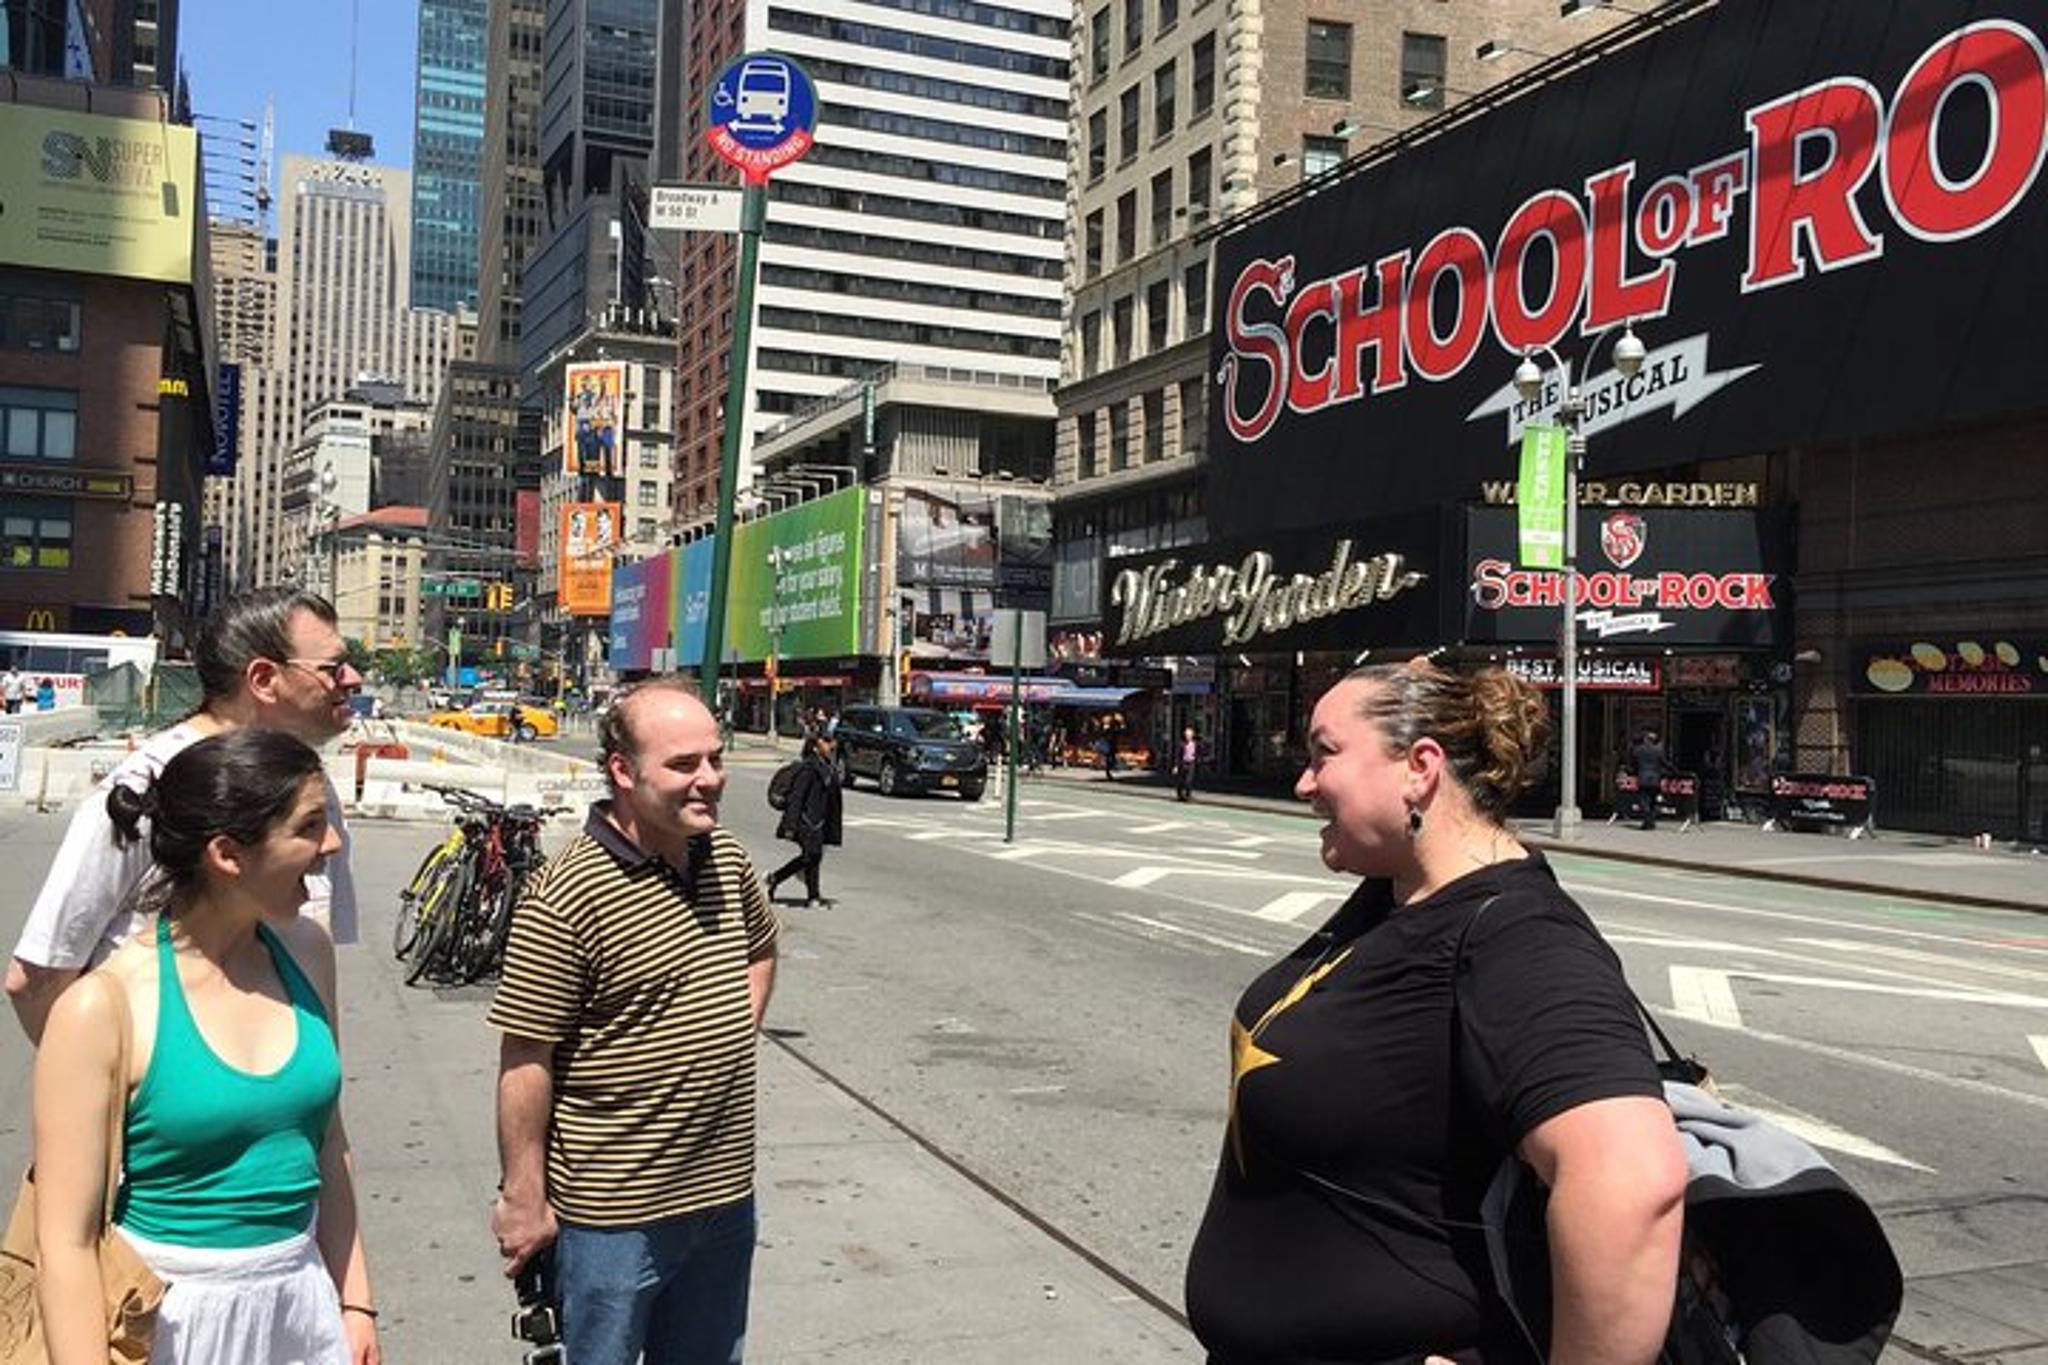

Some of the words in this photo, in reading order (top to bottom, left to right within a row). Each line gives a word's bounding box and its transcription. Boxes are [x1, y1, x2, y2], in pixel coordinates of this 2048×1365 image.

[112, 139, 163, 165] SUPER
[655, 190, 707, 205] Broadway
[1218, 161, 1676, 442] SCHOOL
[1634, 148, 1750, 258] OF
[1513, 379, 1560, 424] THE
[1553, 354, 1689, 426] USICAL
[210, 372, 233, 464] NOVOTEL
[1618, 481, 1759, 506] GARDEN
[1111, 558, 1236, 646] Winter
[1221, 539, 1427, 646] Garden
[1470, 558, 1642, 609] SCHOOL
[1657, 571, 1777, 609] ROCK
[1505, 659, 1557, 675] BEST
[1566, 660, 1651, 677] USICAL
[1928, 674, 2032, 692] MEMORIES
